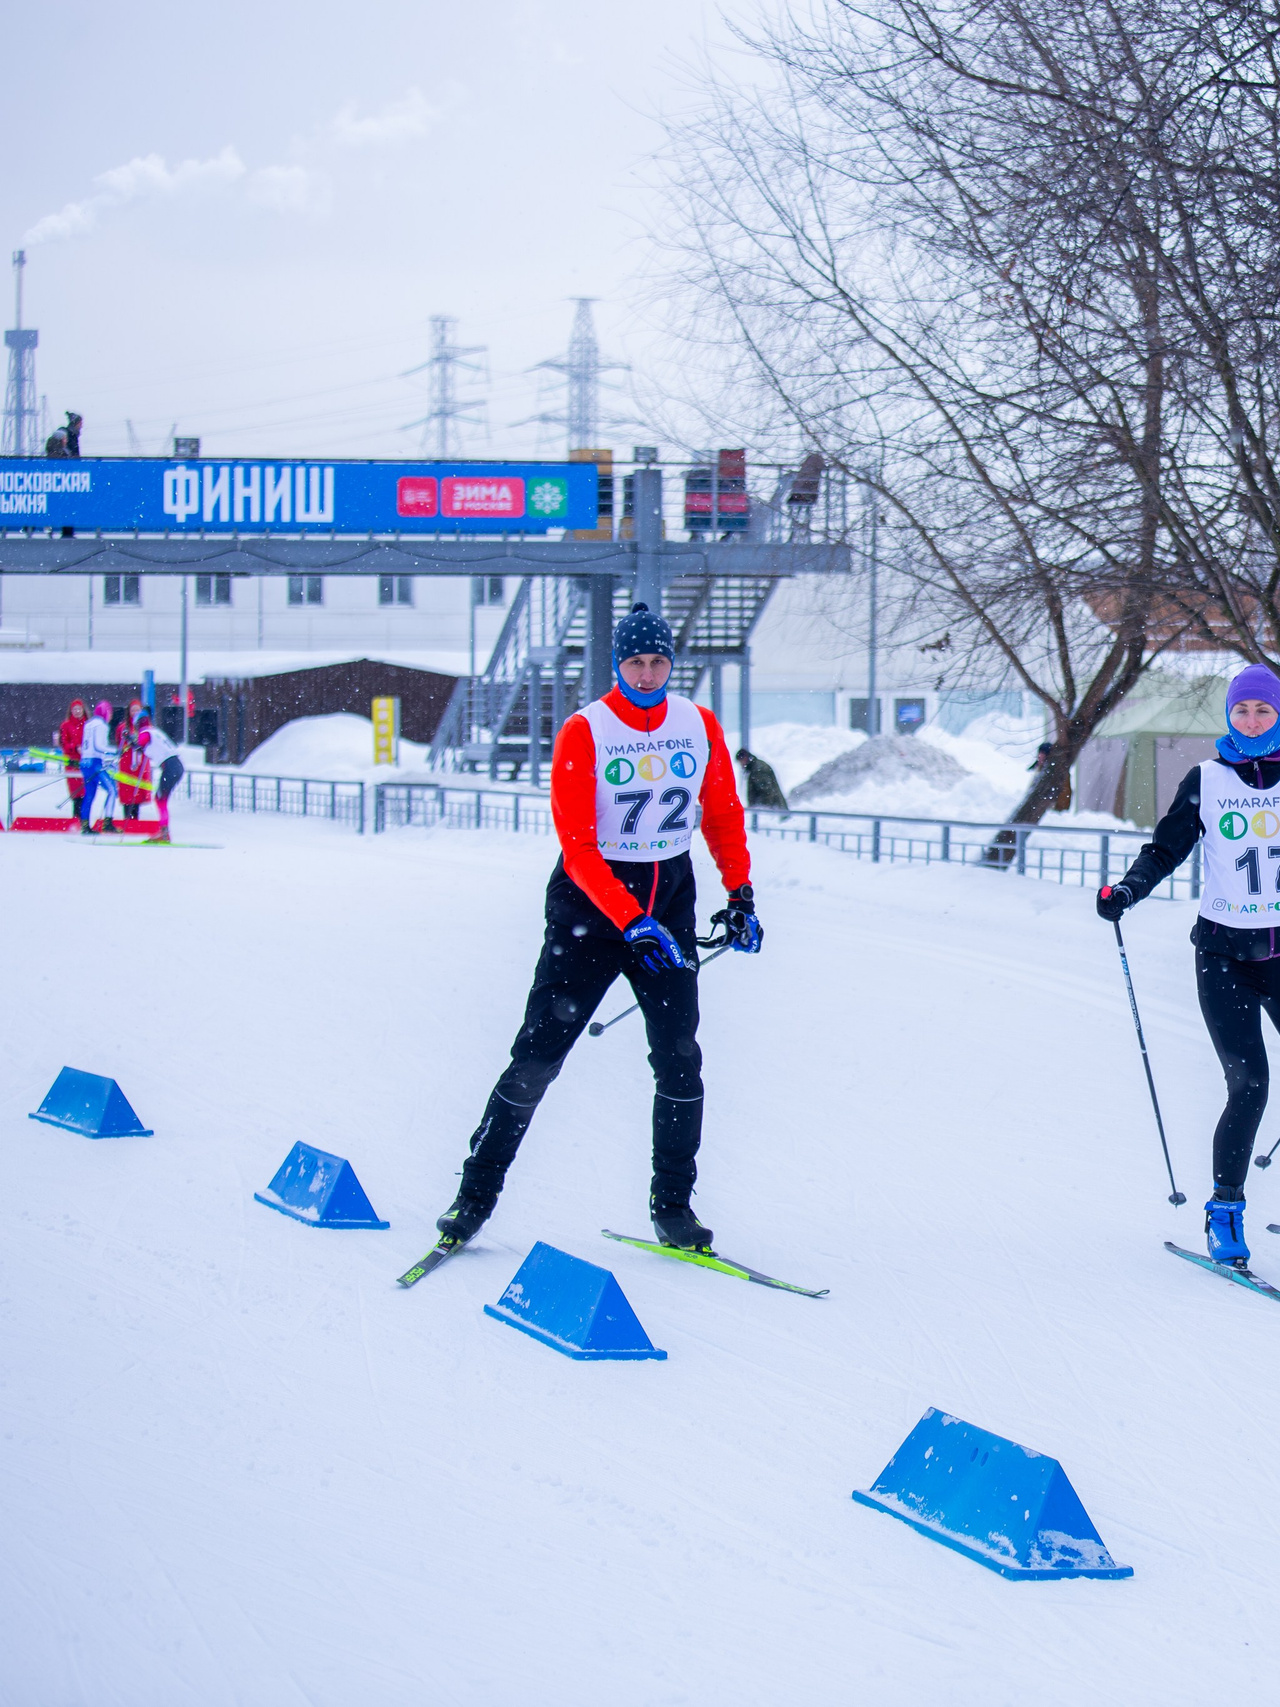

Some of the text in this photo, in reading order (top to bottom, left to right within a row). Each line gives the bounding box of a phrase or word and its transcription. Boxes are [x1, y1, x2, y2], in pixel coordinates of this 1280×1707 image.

[163, 465, 335, 523] ФИНИШ
[453, 484, 512, 500] ЗИМА
[0, 493, 47, 514] ЫЖНЯ
[452, 502, 513, 511] В МОСКВЕ
[605, 738, 695, 756] VMARAFONE
[614, 786, 692, 835] 72
[669, 944, 682, 964] COXA
